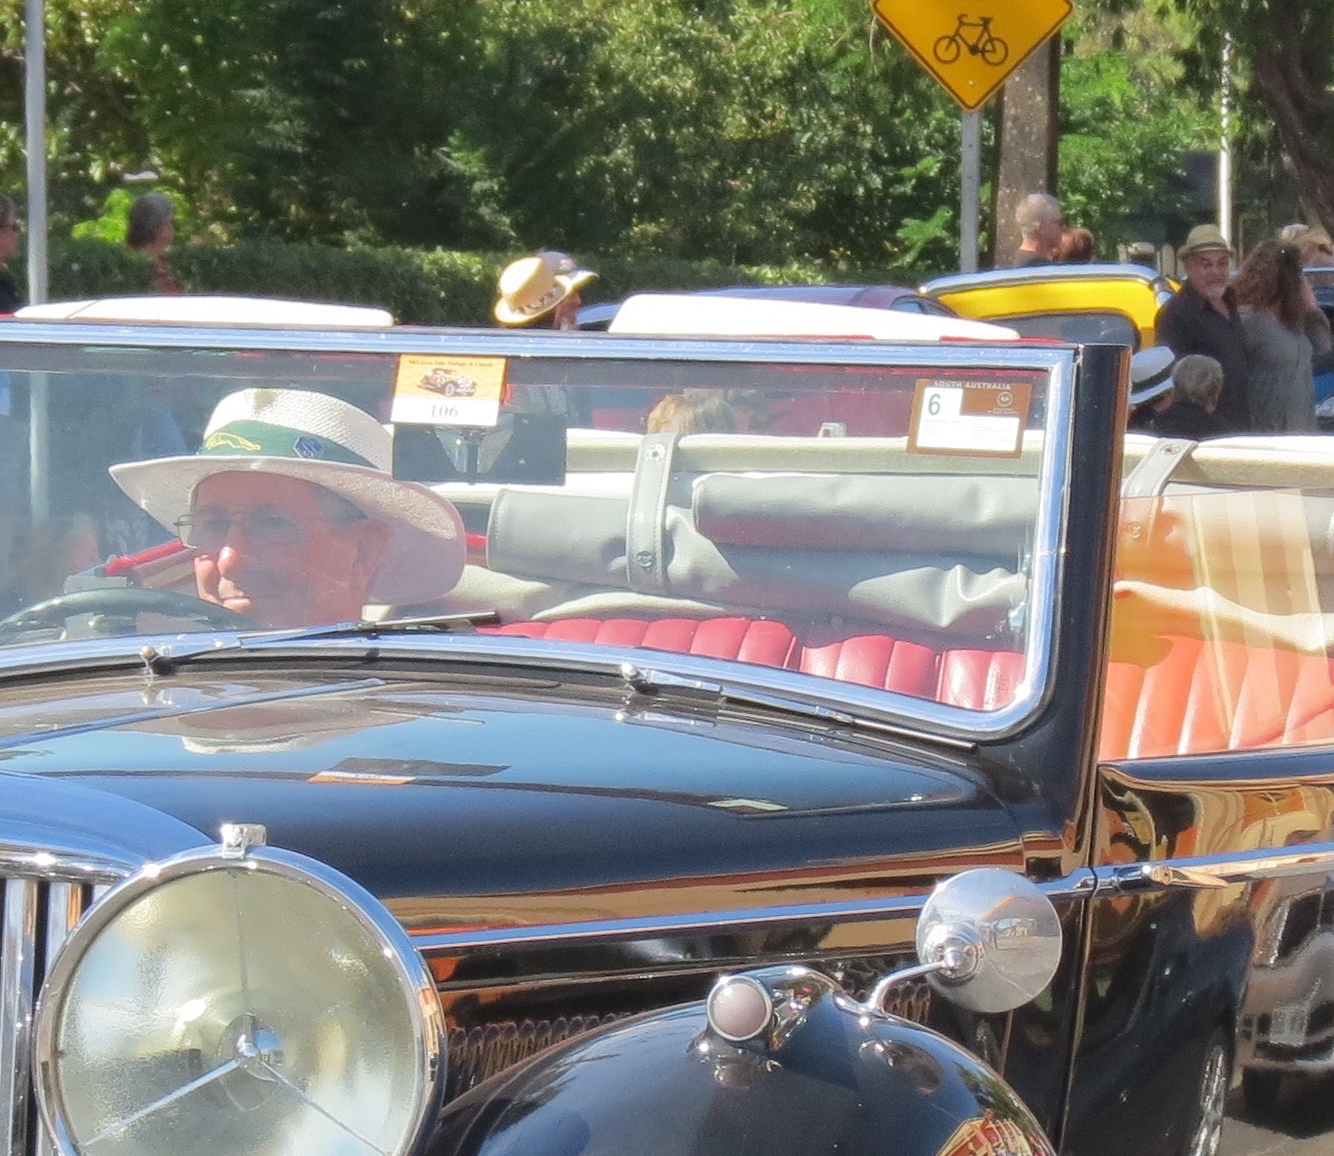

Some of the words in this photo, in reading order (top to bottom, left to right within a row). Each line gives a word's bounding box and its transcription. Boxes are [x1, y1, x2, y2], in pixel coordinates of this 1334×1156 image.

[933, 380, 963, 388] SOUTH
[964, 381, 1012, 391] AUSTRALIA
[430, 403, 459, 419] 106
[928, 393, 942, 416] 6
